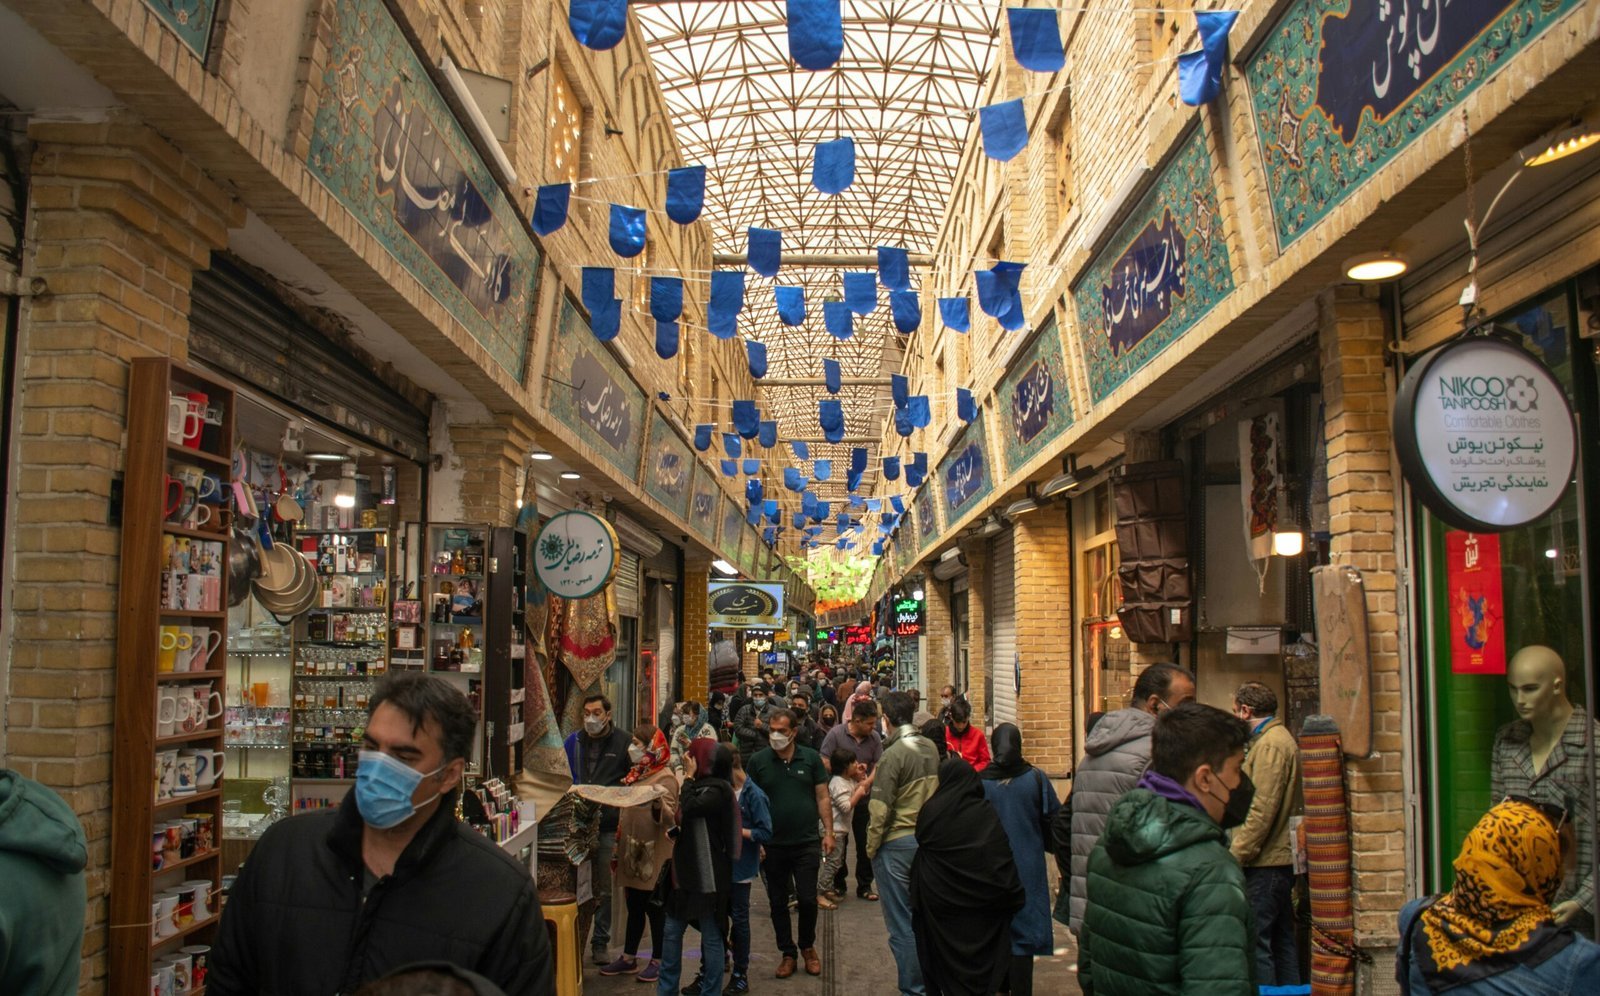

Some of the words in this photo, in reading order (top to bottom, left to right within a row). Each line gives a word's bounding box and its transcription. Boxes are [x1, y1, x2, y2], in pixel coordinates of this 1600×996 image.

[1439, 376, 1505, 397] NIKOO
[1438, 397, 1507, 410] TANPOOSH
[1444, 414, 1502, 428] Comfortable
[1505, 414, 1541, 428] Clothes
[1452, 476, 1496, 492] تجریش
[1497, 475, 1549, 491] نمایندگی
[585, 538, 603, 562] ترمه
[720, 595, 758, 614] نیری
